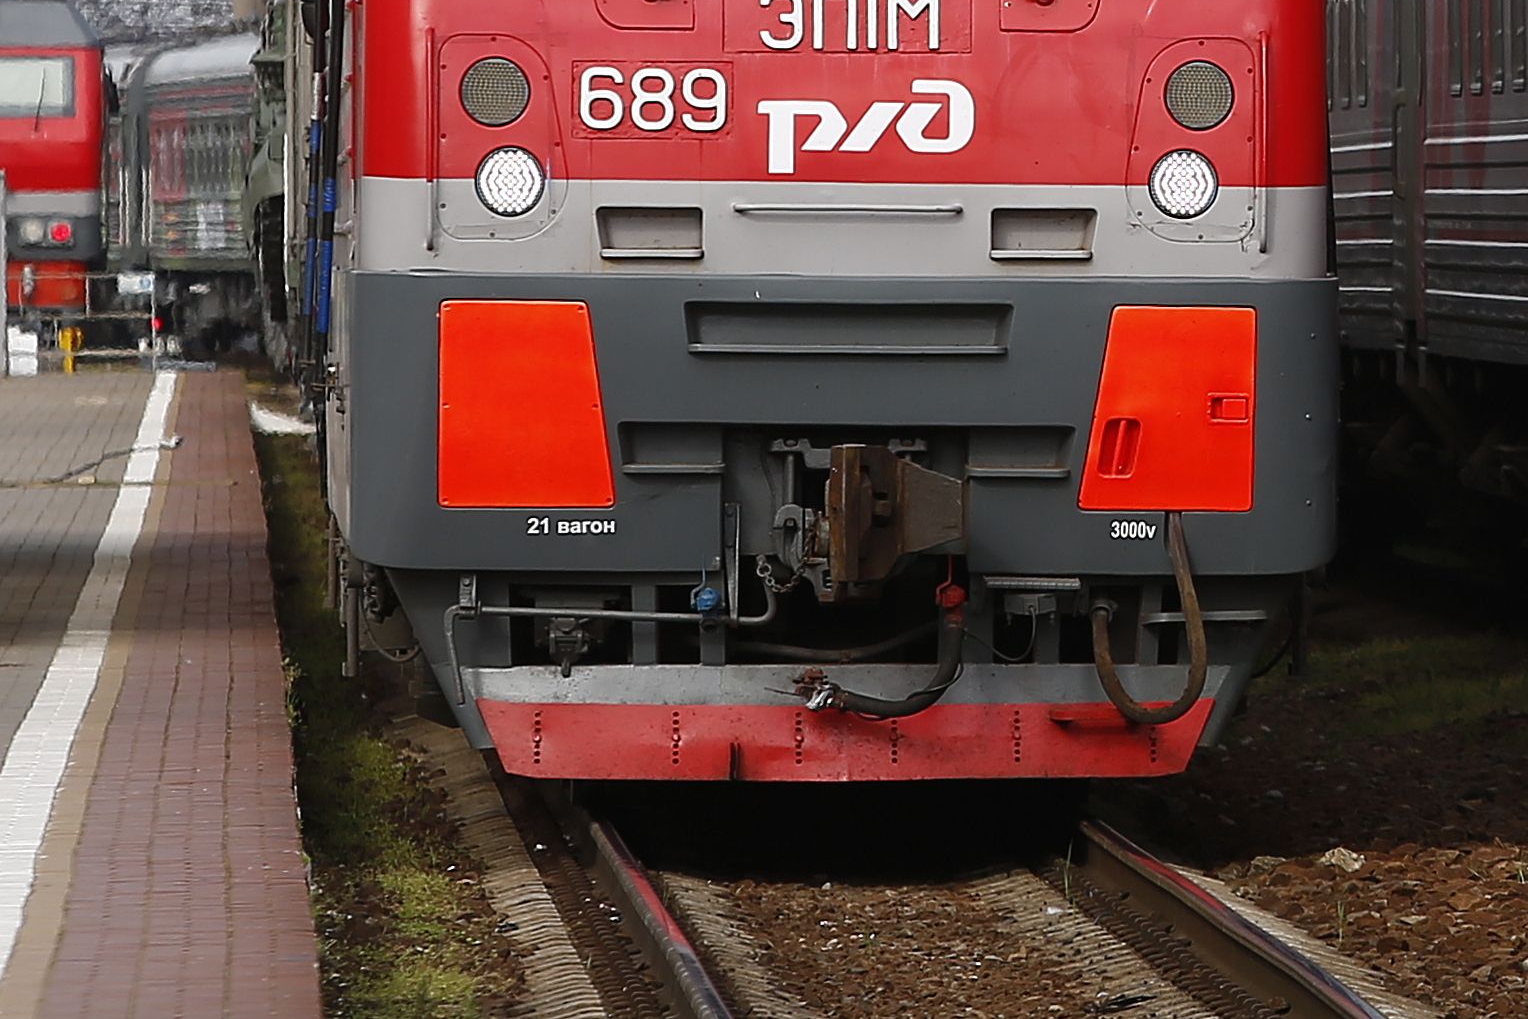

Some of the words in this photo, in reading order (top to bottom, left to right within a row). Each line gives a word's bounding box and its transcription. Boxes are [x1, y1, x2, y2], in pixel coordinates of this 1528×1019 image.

[578, 66, 729, 132] 689
[526, 516, 550, 535] 21
[556, 519, 616, 534] вагон
[1109, 520, 1157, 539] 3000v
